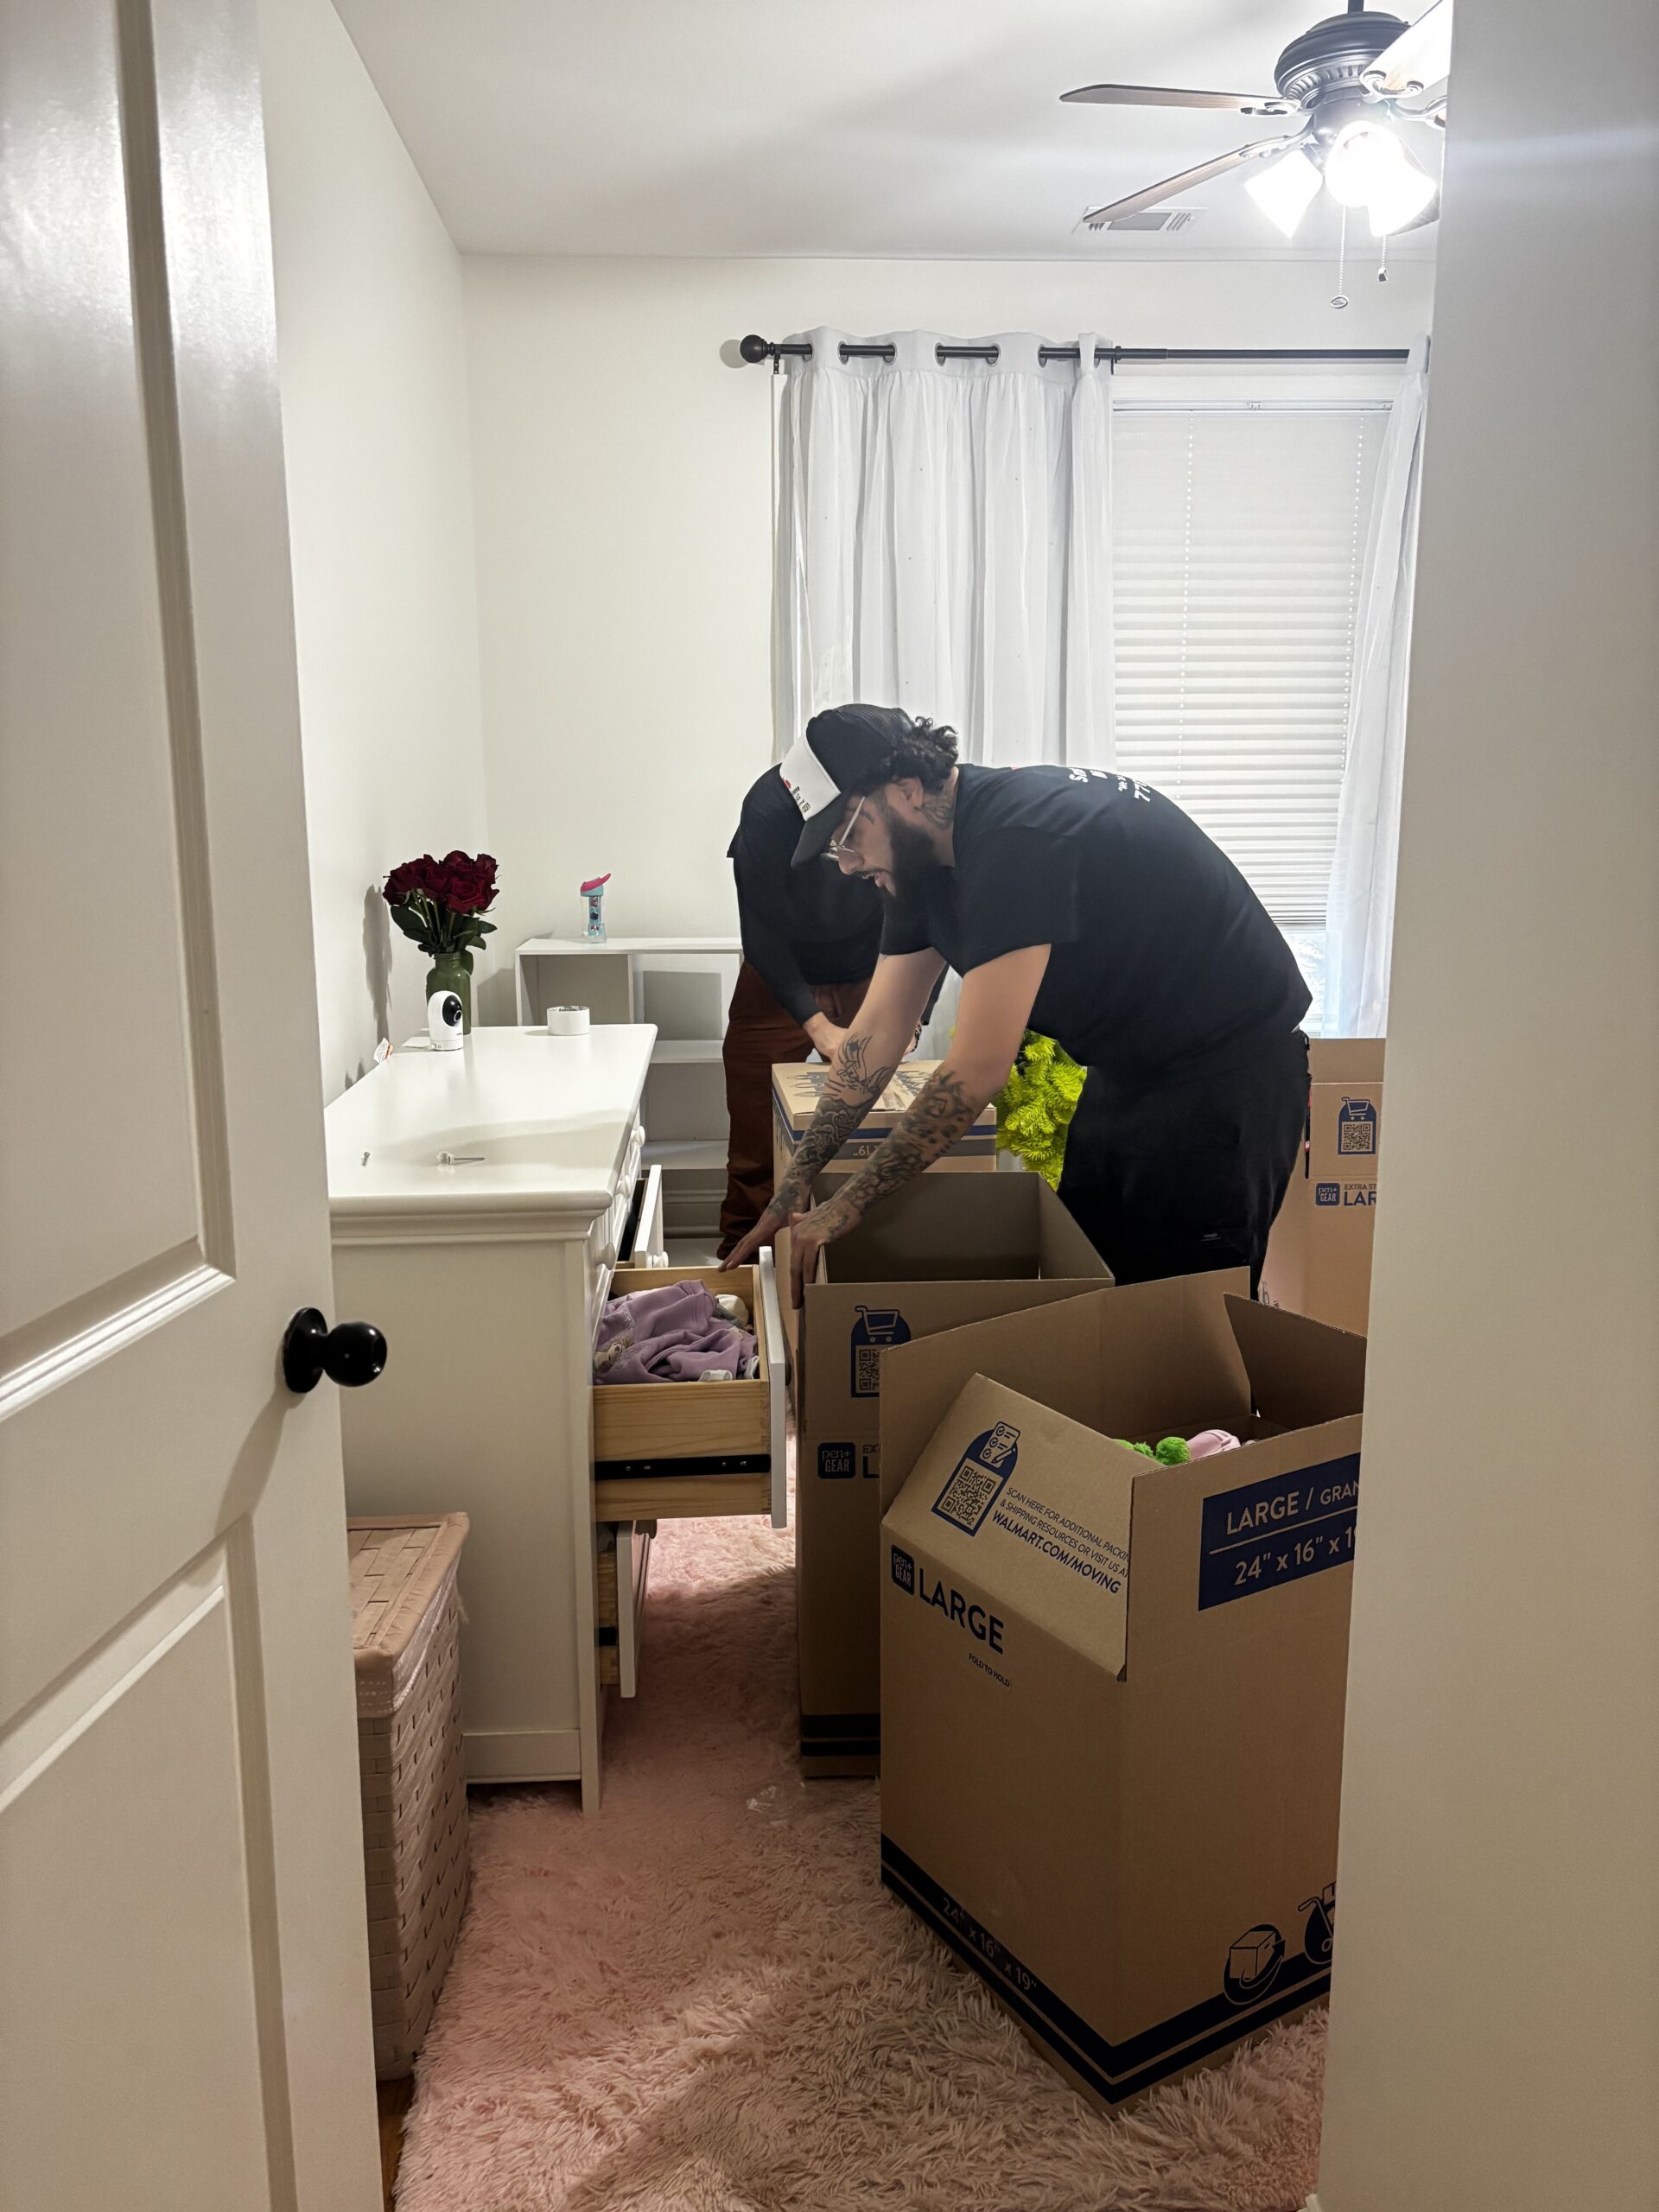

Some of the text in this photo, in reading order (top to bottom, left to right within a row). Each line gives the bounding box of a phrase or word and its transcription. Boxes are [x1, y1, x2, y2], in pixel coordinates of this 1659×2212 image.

[825, 1459, 849, 1472] GEAR
[1007, 1487, 1027, 1503] SCAN
[1026, 1497, 1046, 1513] HERE
[1044, 1508, 1060, 1522] FOR
[1059, 1517, 1102, 1547] ADDITIONAL
[1227, 1491, 1299, 1535] LARGE
[1306, 1486, 1313, 1510] /
[992, 1510, 1122, 1593] WALMART.COM/MOVING
[1006, 1502, 1038, 1525] SHIPPING
[1037, 1519, 1078, 1549] RESOURCES
[1078, 1543, 1090, 1556] OR
[1092, 1549, 1109, 1567] VISIT
[1108, 1560, 1120, 1573] US
[1235, 1552, 1271, 1585] 24"
[1275, 1554, 1288, 1572] x
[1294, 1536, 1324, 1565] 16"
[1328, 1537, 1340, 1554] x
[895, 1564, 912, 1588] GEAR
[919, 1567, 1004, 1655] LARGE
[969, 1653, 1009, 1688] FOLD TO HOLD
